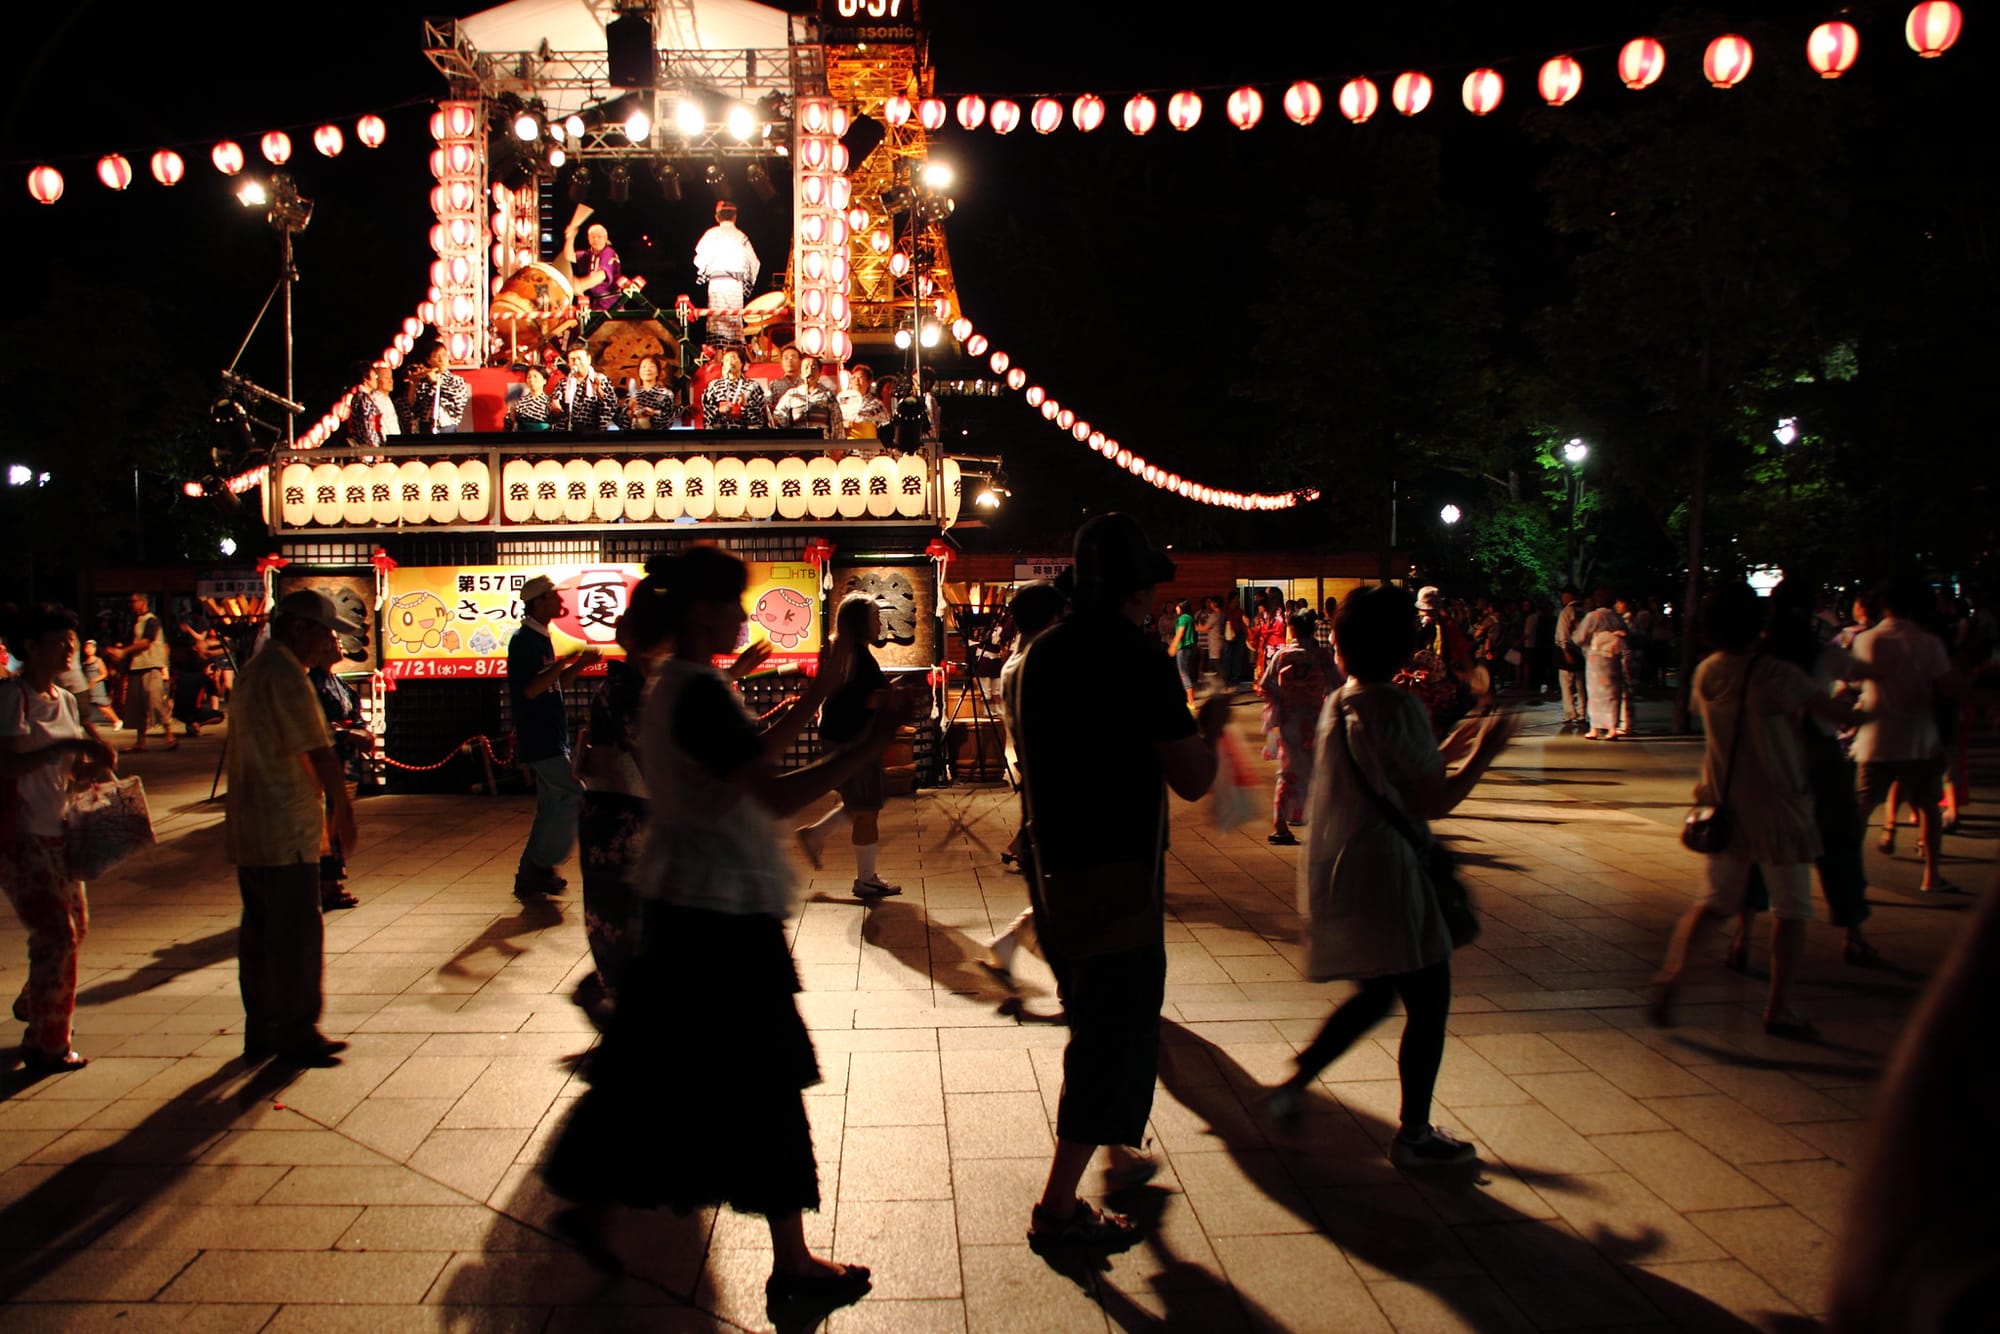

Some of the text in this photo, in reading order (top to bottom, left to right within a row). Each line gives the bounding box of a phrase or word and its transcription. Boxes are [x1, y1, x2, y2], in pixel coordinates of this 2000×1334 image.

[822, 24, 914, 39] Panasonic
[317, 485, 336, 504] 祭
[346, 485, 365, 504] 祭
[371, 483, 390, 502] 祭
[402, 483, 420, 502] 祭
[431, 483, 449, 502] 祭
[461, 482, 480, 501] 祭
[510, 483, 529, 501] 祭
[537, 482, 556, 500] 祭
[567, 481, 586, 501] 祭
[598, 480, 618, 499] 祭
[626, 481, 645, 500] 祭
[656, 478, 673, 498] 祭
[685, 476, 704, 498] 祭
[718, 478, 738, 497] 祭
[749, 479, 769, 499] 祭
[781, 478, 801, 498] 祭
[812, 477, 831, 497] 祭
[841, 477, 861, 496] 祭
[869, 475, 888, 496] 祭
[901, 474, 922, 496] 祭
[285, 486, 305, 505] 祭
[458, 575, 526, 592] 第57回
[792, 569, 817, 579] HTB
[575, 581, 628, 627] 夏
